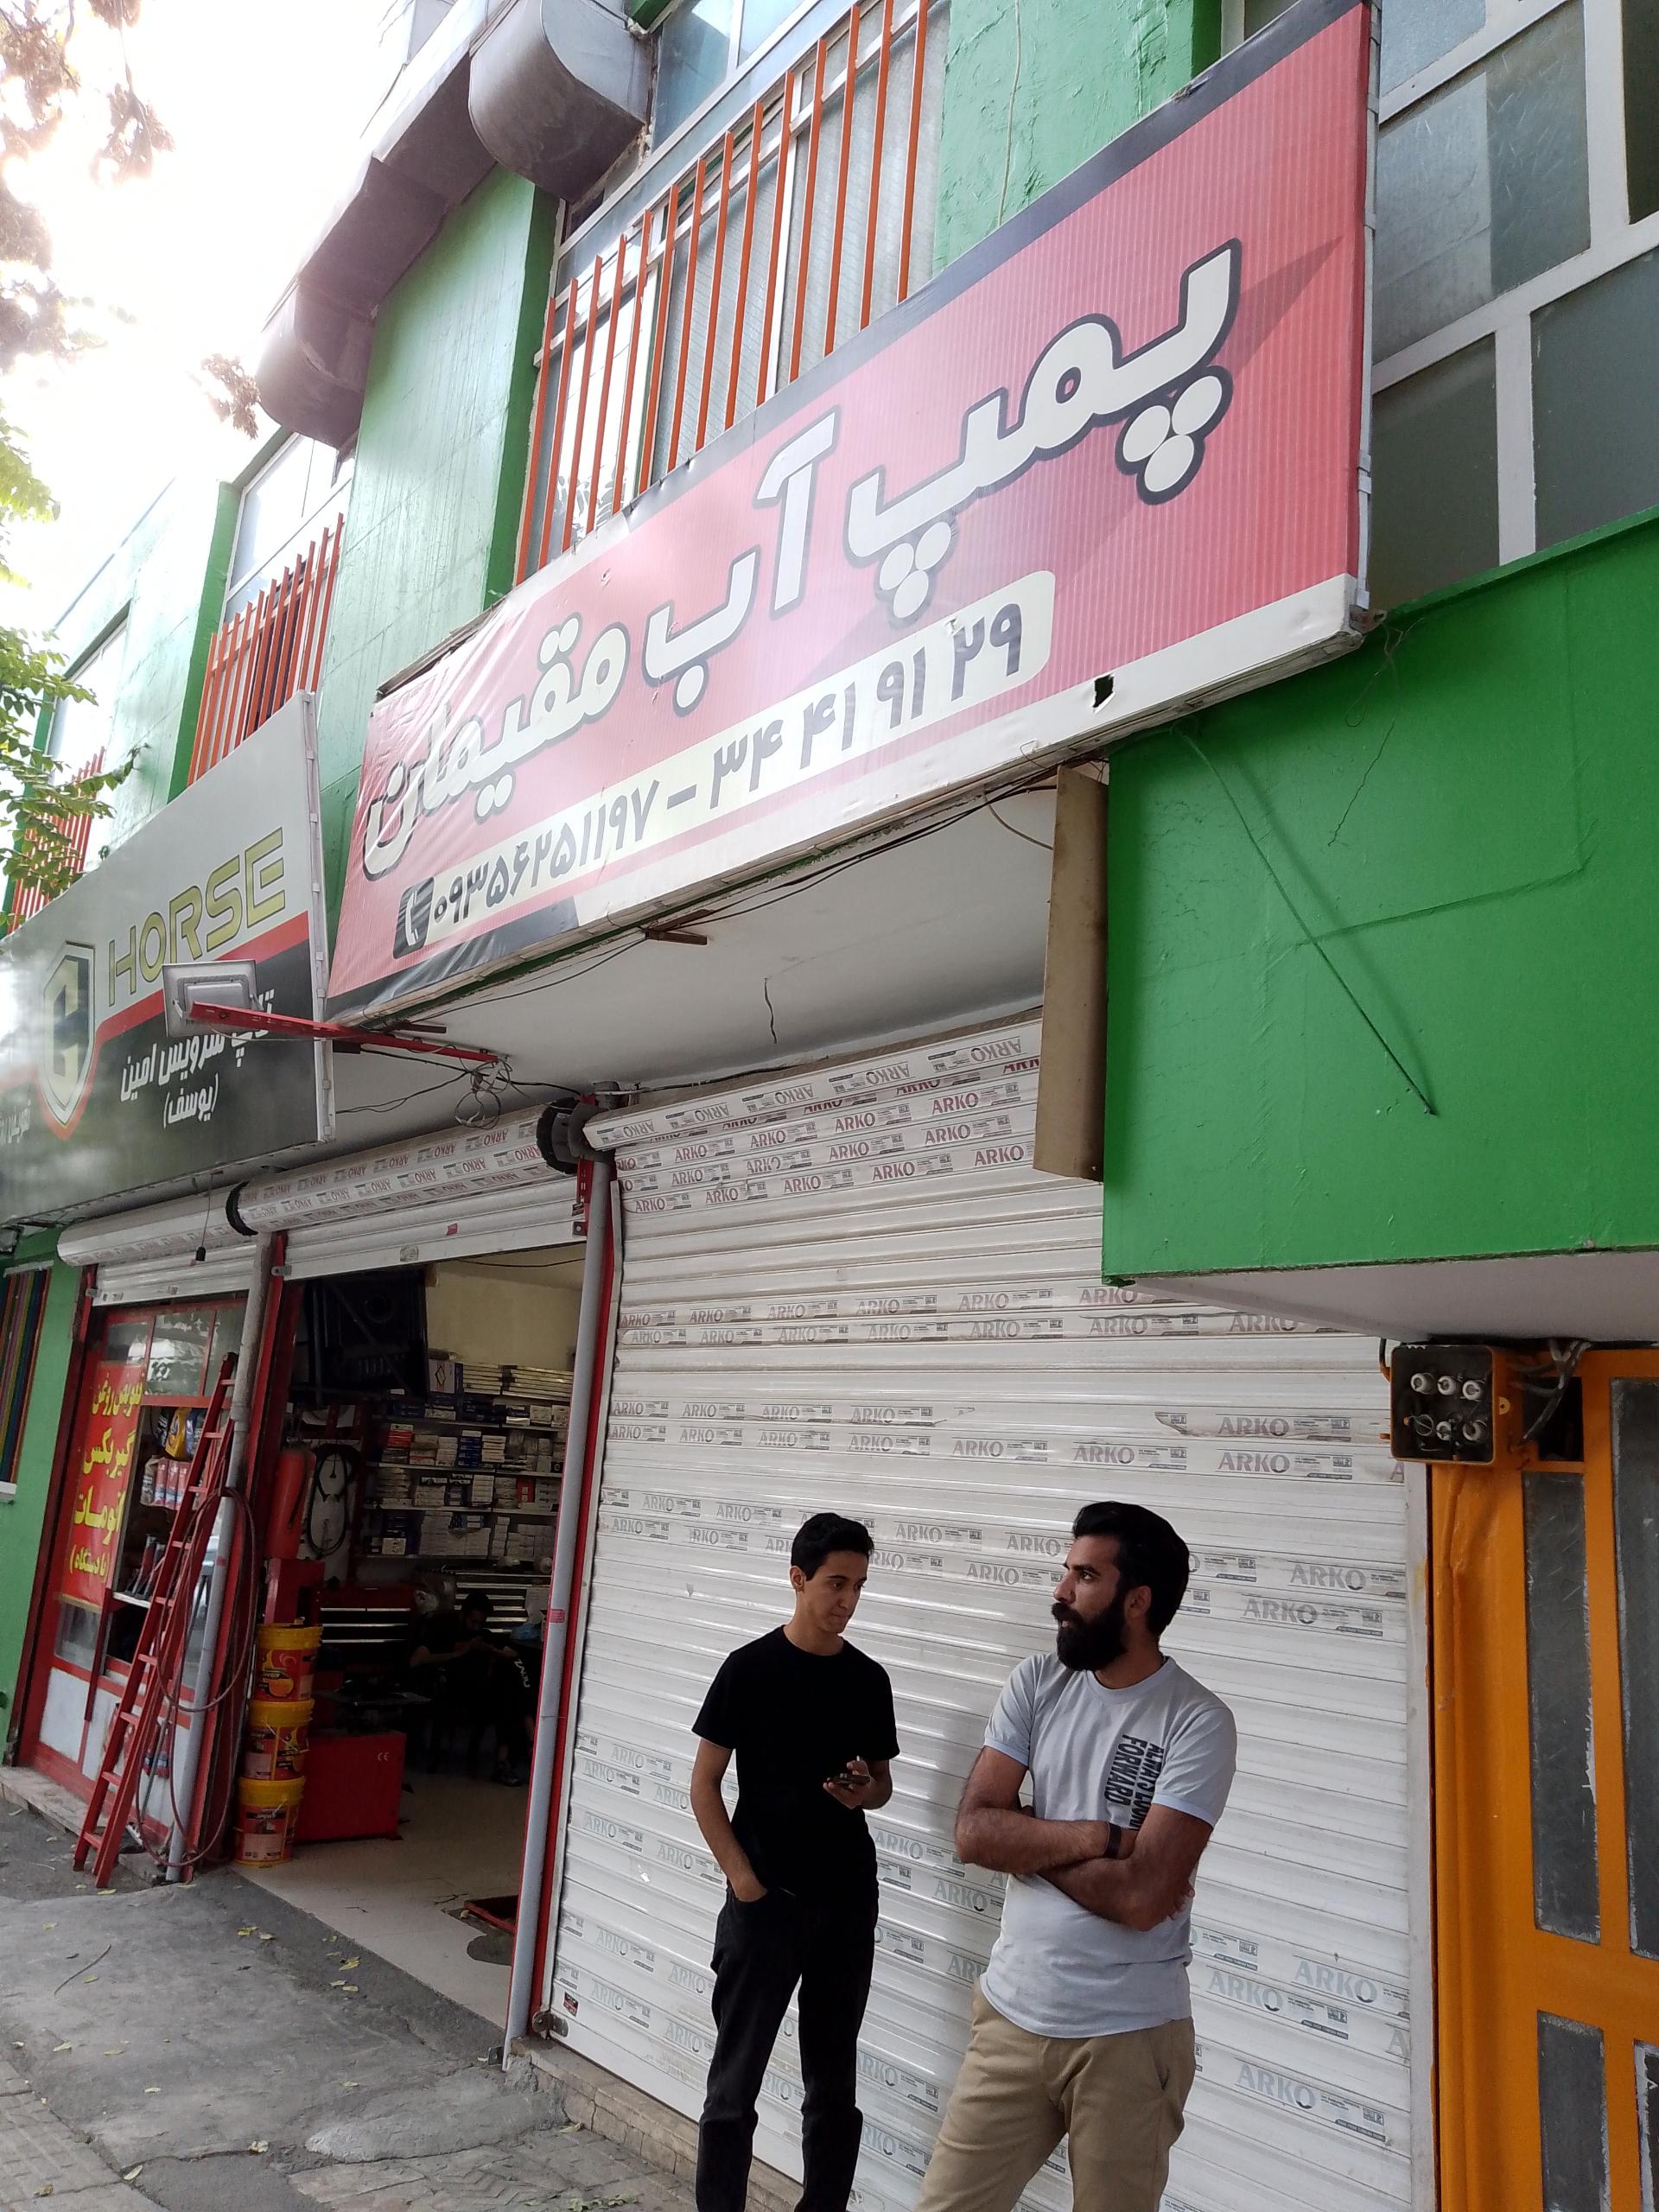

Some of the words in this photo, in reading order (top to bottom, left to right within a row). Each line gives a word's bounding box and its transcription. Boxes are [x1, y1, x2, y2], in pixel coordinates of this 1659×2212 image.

[842, 237, 1243, 631] پمپ
[643, 404, 842, 716] آب
[363, 612, 632, 881] مقیمان
[108, 827, 286, 1007] HORSE
[121, 1043, 157, 1103] امین
[158, 1033, 226, 1086] سرویس
[163, 1072, 219, 1129] (یوسف)
[675, 1144, 708, 1161] ARKO
[750, 1129, 786, 1147] ARKO
[835, 1112, 875, 1133] ARKO
[932, 1092, 979, 1115] ARKO
[635, 1198, 665, 1212] ARKO
[705, 1187, 739, 1204] ARKO
[784, 1175, 821, 1192] ARKO
[872, 1161, 914, 1181] ARKO
[975, 1145, 1024, 1166] ARKO
[671, 1169, 703, 1186] ARKO
[747, 1157, 781, 1173] ARKO
[830, 1141, 869, 1160] ARKO
[925, 1124, 970, 1145] ARKO
[622, 1313, 651, 1326] ARKO
[690, 1309, 723, 1323] ARKO
[767, 1304, 805, 1319] ARKO
[857, 1299, 900, 1314] ARKO
[958, 1293, 1009, 1310] ARKO
[1079, 1287, 1138, 1304] ARKO
[701, 1330, 734, 1344] ARKO
[779, 1327, 817, 1342] ARKO
[868, 1325, 912, 1340] ARKO
[969, 1321, 1020, 1338] ARKO
[1089, 1317, 1147, 1336] ARKO
[613, 1402, 644, 1416] ARKO
[683, 1403, 716, 1418] ARKO
[850, 1408, 895, 1424] ARKO
[1217, 1417, 1290, 1437] ARKO
[610, 1426, 641, 1440] ARKO
[680, 1427, 715, 1443] ARKO
[849, 1435, 893, 1452] ARKO
[952, 1440, 1003, 1458] ARKO
[1073, 1444, 1135, 1465] ARKO
[1217, 1452, 1290, 1473] ARKO
[613, 1518, 643, 1534] ARKO
[967, 1563, 1020, 1586] ARKO
[1243, 1598, 1318, 1624] ARKO
[643, 1496, 674, 1511] ARKO
[716, 1504, 751, 1522] ARKO
[895, 1522, 943, 1543] ARKO
[1007, 1535, 1062, 1557] ARKO
[1290, 1563, 1365, 1591] ARKO
[612, 1747, 644, 1768] ARKO
[1104, 1734, 1147, 1806] FORWARD
[584, 1762, 615, 1783] ARKO
[655, 1784, 689, 1809] ARKO
[584, 1815, 617, 1838] ARKO
[657, 1844, 694, 1870] ARKO
[874, 1831, 924, 1859] ARKO
[933, 1879, 986, 1912] ARKO
[595, 1928, 629, 1956] ARKO
[667, 1963, 706, 1993] ARKO
[1294, 1961, 1378, 2004] ARKO
[1209, 1970, 1283, 2012] ARKO
[664, 2022, 702, 2053] ARKO
[1236, 2063, 1315, 2109] ARKO
